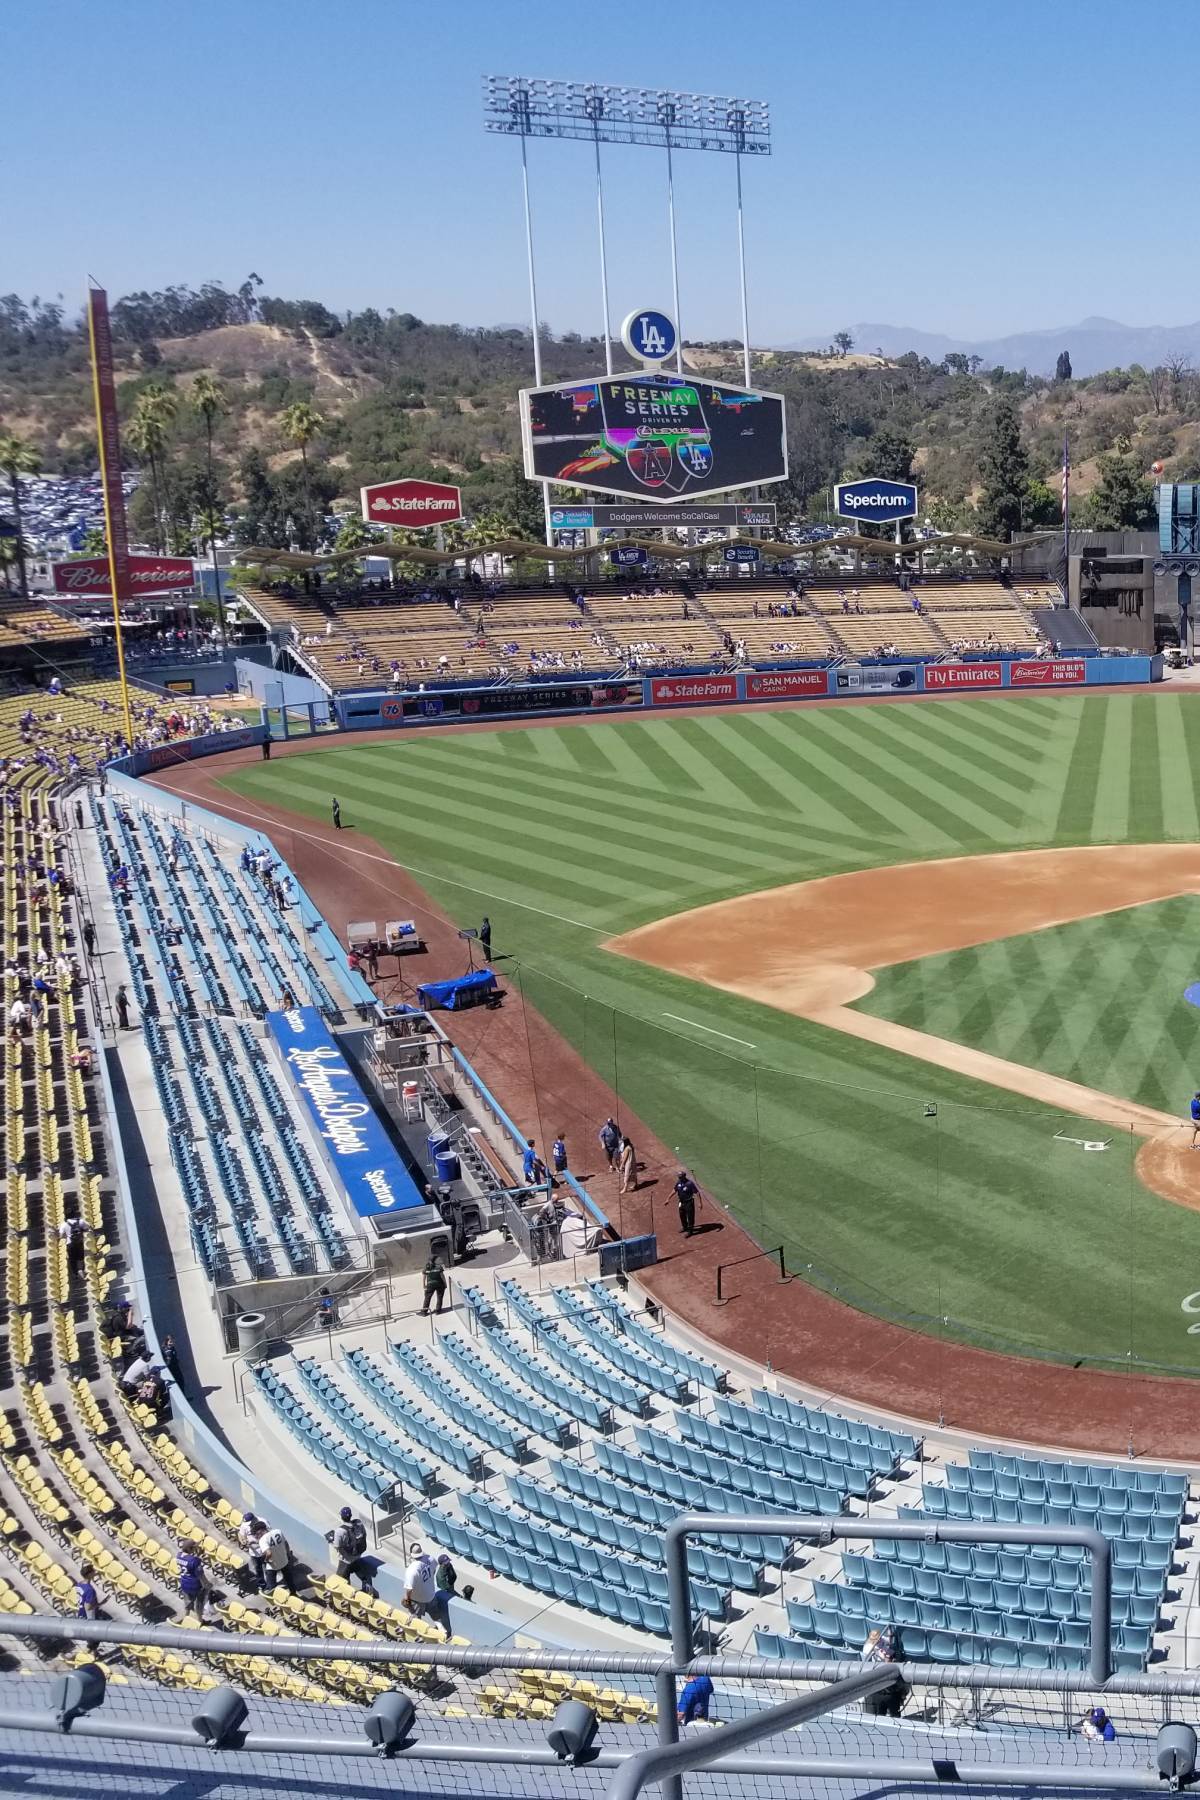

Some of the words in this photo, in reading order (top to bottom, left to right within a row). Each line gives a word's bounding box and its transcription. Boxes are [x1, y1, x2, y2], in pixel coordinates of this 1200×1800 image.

[639, 317, 665, 353] LA
[610, 385, 692, 404] FREEWAY
[624, 401, 689, 416] SERIES
[652, 427, 690, 435] LEXUS
[686, 441, 708, 470] LA
[843, 493, 907, 509] Spectrum
[609, 512, 646, 522] Dodgers
[646, 512, 680, 520] Welcome
[762, 677, 783, 686] SAN
[783, 675, 823, 685] MANUEL
[926, 670, 947, 684] Fly
[948, 666, 1000, 682] Emirates
[1065, 671, 1079, 679] YOU.
[532, 691, 567, 700] SERIES
[384, 704, 400, 715] 76
[317, 1102, 370, 1155] Dodgers
[362, 1168, 395, 1208] Spectrum
[268, 1533, 283, 1546] 42
[422, 1569, 433, 1583] 21
